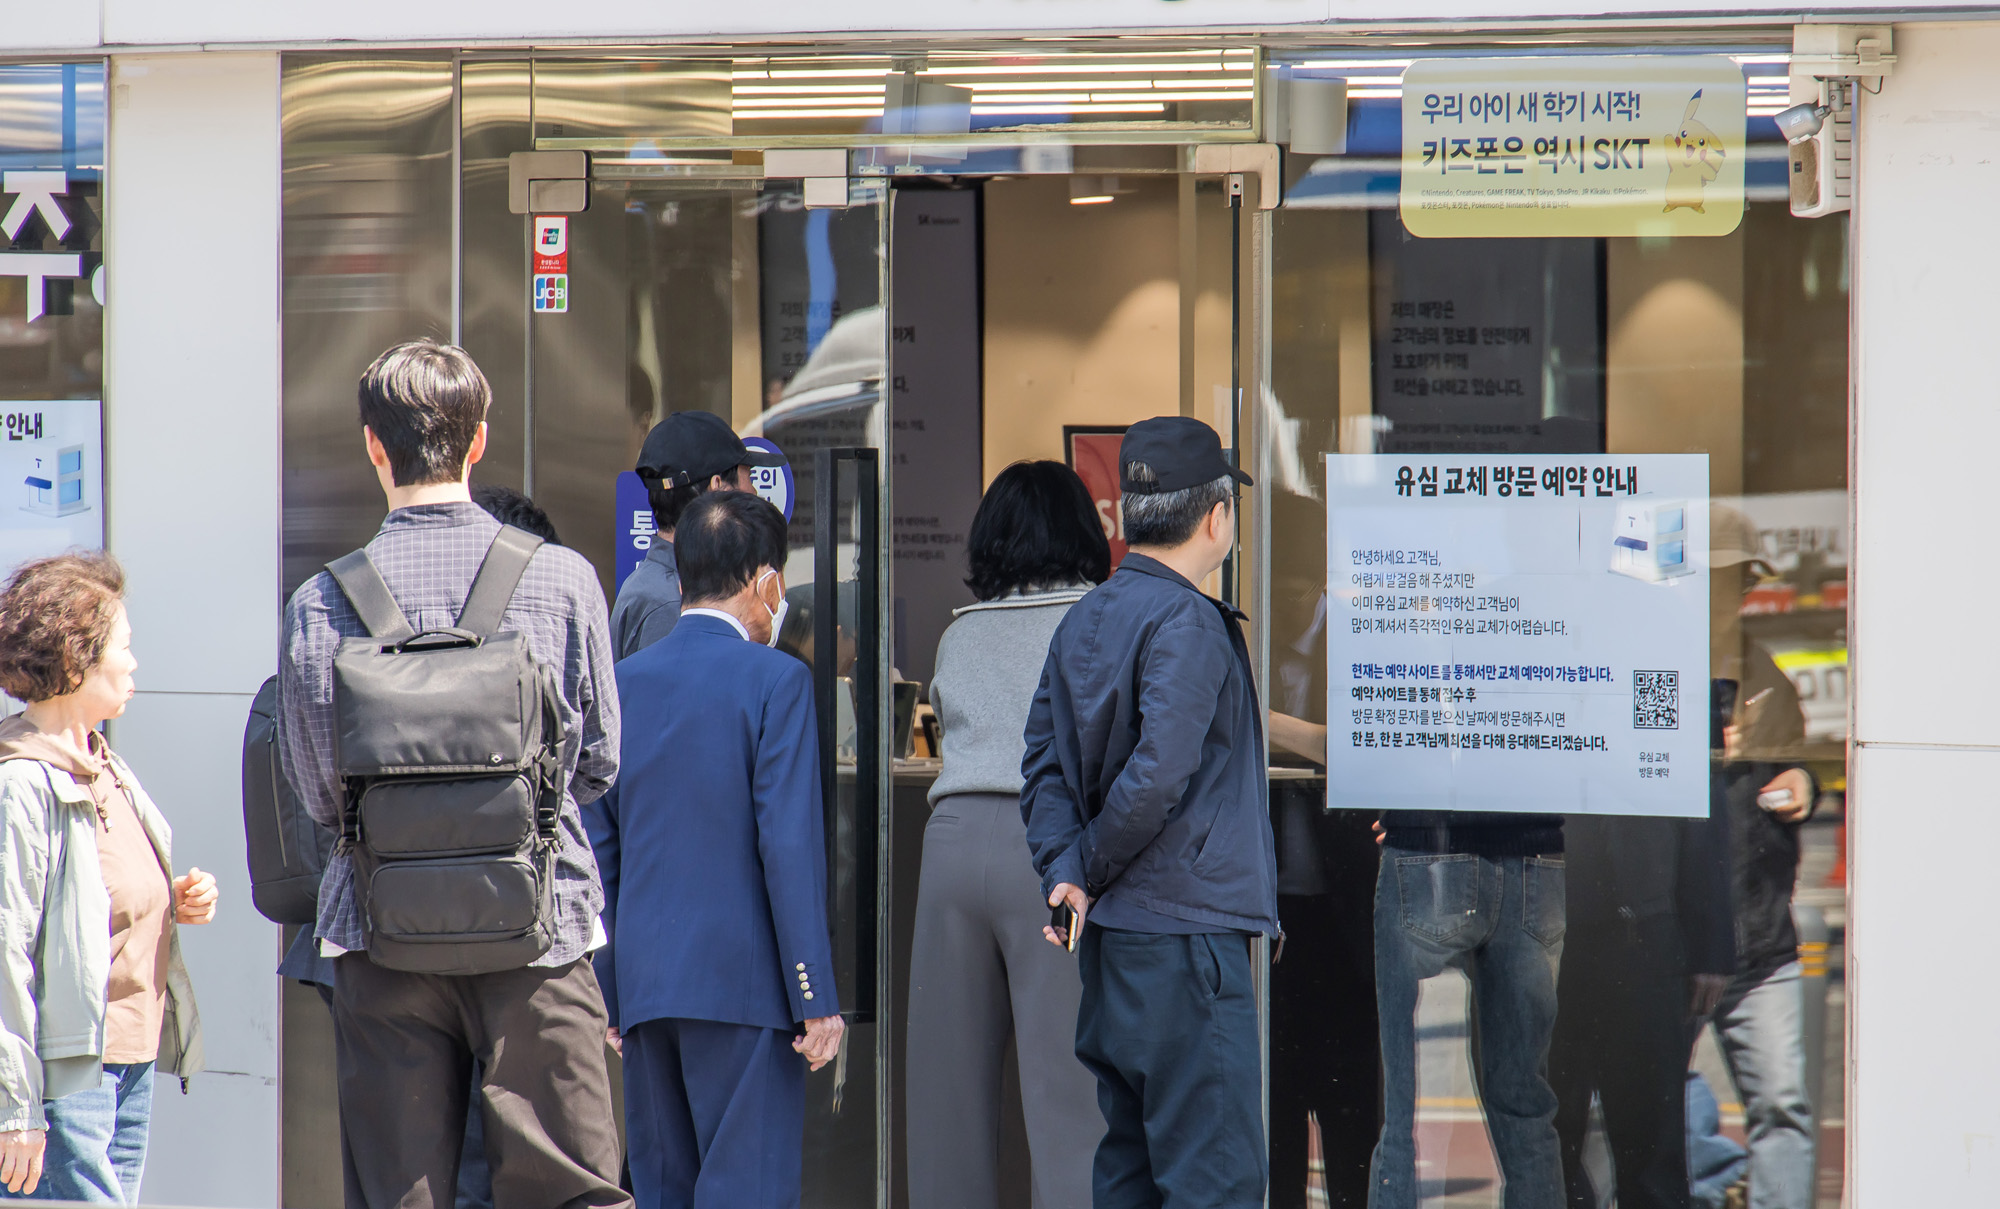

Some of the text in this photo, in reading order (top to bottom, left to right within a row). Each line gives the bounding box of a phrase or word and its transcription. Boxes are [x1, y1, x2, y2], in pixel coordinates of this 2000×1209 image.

[1421, 90, 1641, 124] 우리 아이 새 학기 시작!
[1422, 135, 1651, 175] 키즈폰은 역시 SKT
[1487, 188, 1504, 196] GAME
[1527, 188, 1535, 196] TV
[1536, 188, 1555, 198] Tokyo,
[0, 170, 104, 324] 주
[536, 287, 565, 300] JCB
[1392, 301, 1455, 319] 저희 매장은
[1391, 327, 1440, 345] 고객님의
[1442, 327, 1478, 345] 정보를
[6, 412, 43, 441] 안내
[1395, 466, 1638, 497] 유심 교체 방문 예약 안내
[629, 510, 658, 550] 통
[1351, 549, 1442, 567] 안녕하세요 고객님,
[1351, 572, 1475, 589] 어렵게 발걸음 해 주셨지만
[1351, 595, 1520, 613] 이미 유심 교체를 예약하신 고객님이
[1351, 617, 1568, 636] 많이 계셔서 즉각적인 유심 교체가 어렵습니다.
[1351, 663, 1614, 683] 현재는 예약 사이트를 통해서만 교체 예약이 가능합니다.
[1351, 685, 1477, 703] 예약 사이트를 통해 접수 후
[1351, 708, 1566, 728] 방문 확정 문자를 받으신 날짜에 방문해주시면
[1351, 730, 1609, 752] 한 분, 한 분 고객님께 최선을 다해 응대해드리겠습니다.
[1639, 751, 1670, 763] 유심 교체
[1639, 766, 1670, 778] 방문 예약
